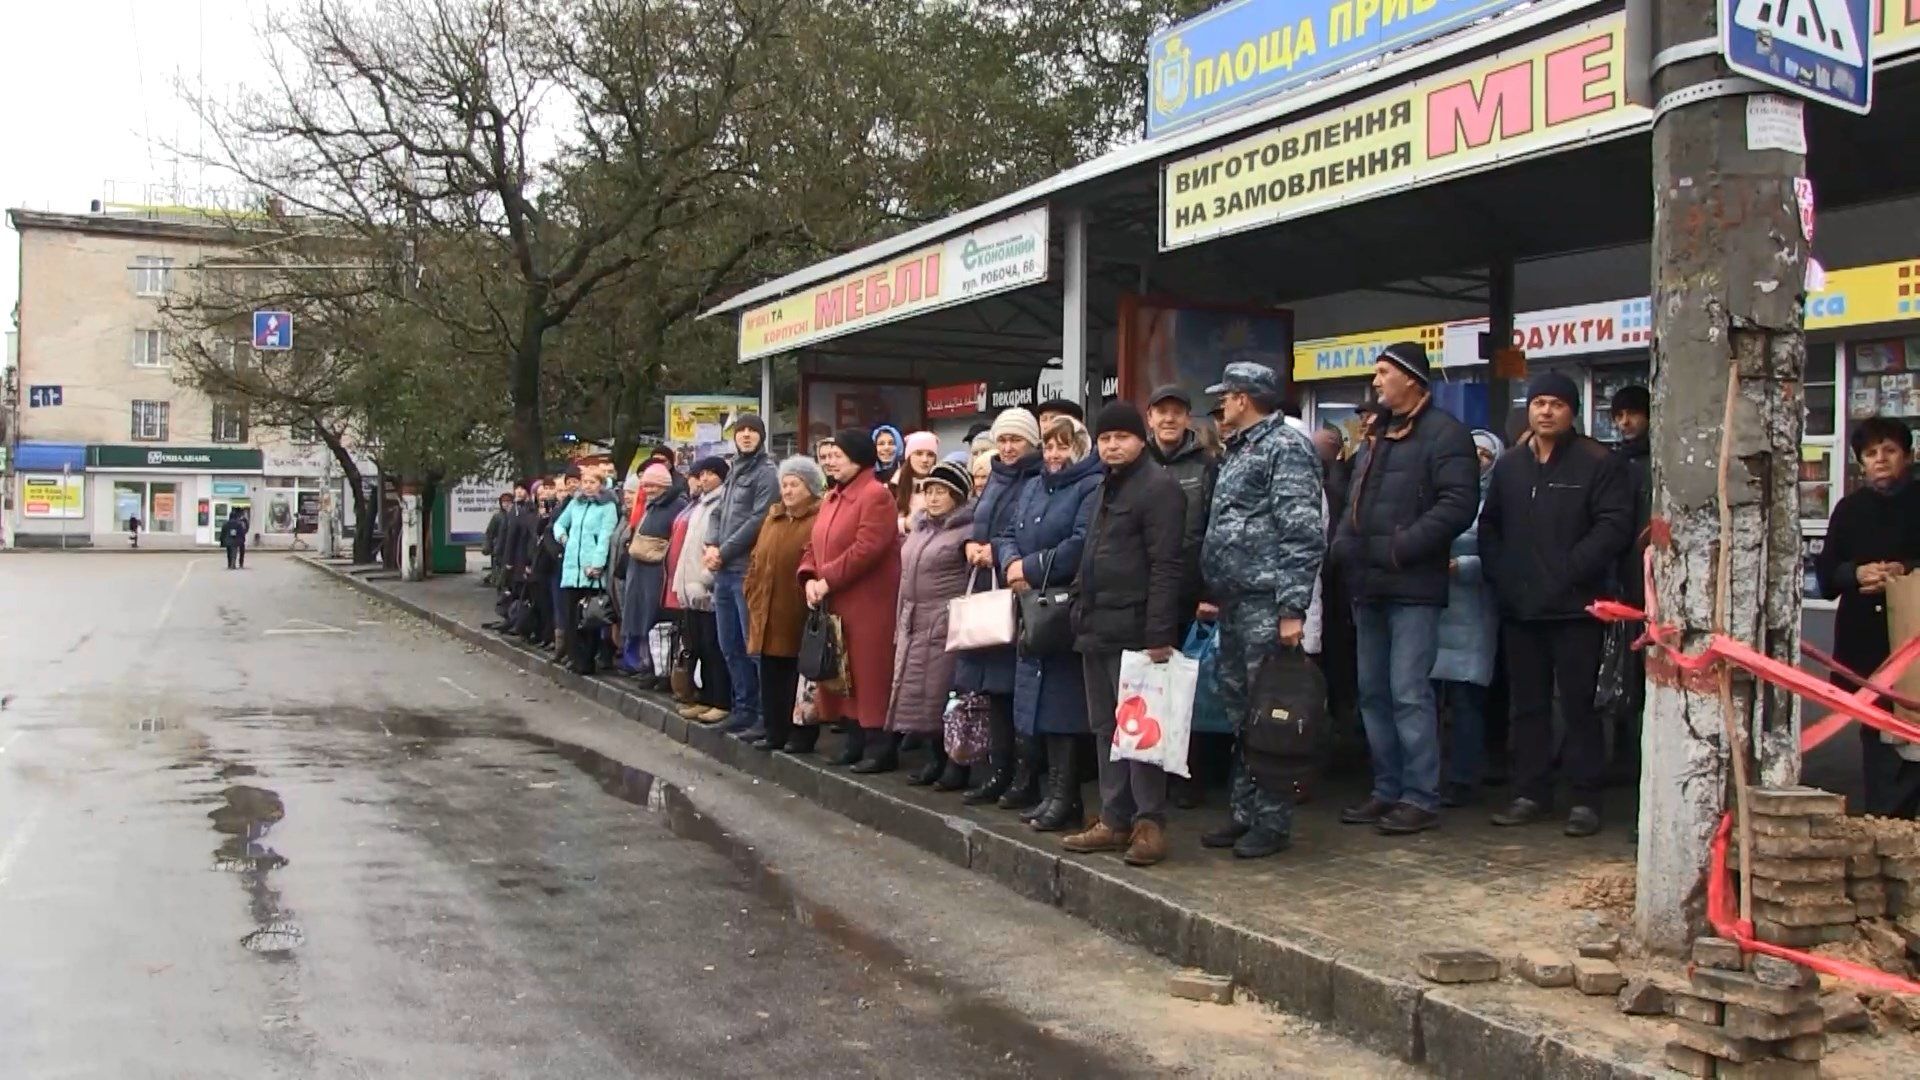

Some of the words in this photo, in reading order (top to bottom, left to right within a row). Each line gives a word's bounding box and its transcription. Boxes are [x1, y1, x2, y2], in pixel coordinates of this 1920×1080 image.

[1194, 17, 1317, 98] ПЛОЩА
[1175, 101, 1412, 195] ВИГОТОВЛЕННЯ
[1426, 34, 1628, 160] МЕ
[1174, 198, 1207, 229] НА
[1212, 141, 1412, 219] ЗАМОВЛЕННЯ
[771, 308, 783, 323] ТА
[815, 254, 941, 330] МЕБЛІ
[992, 388, 1033, 408] пекарня
